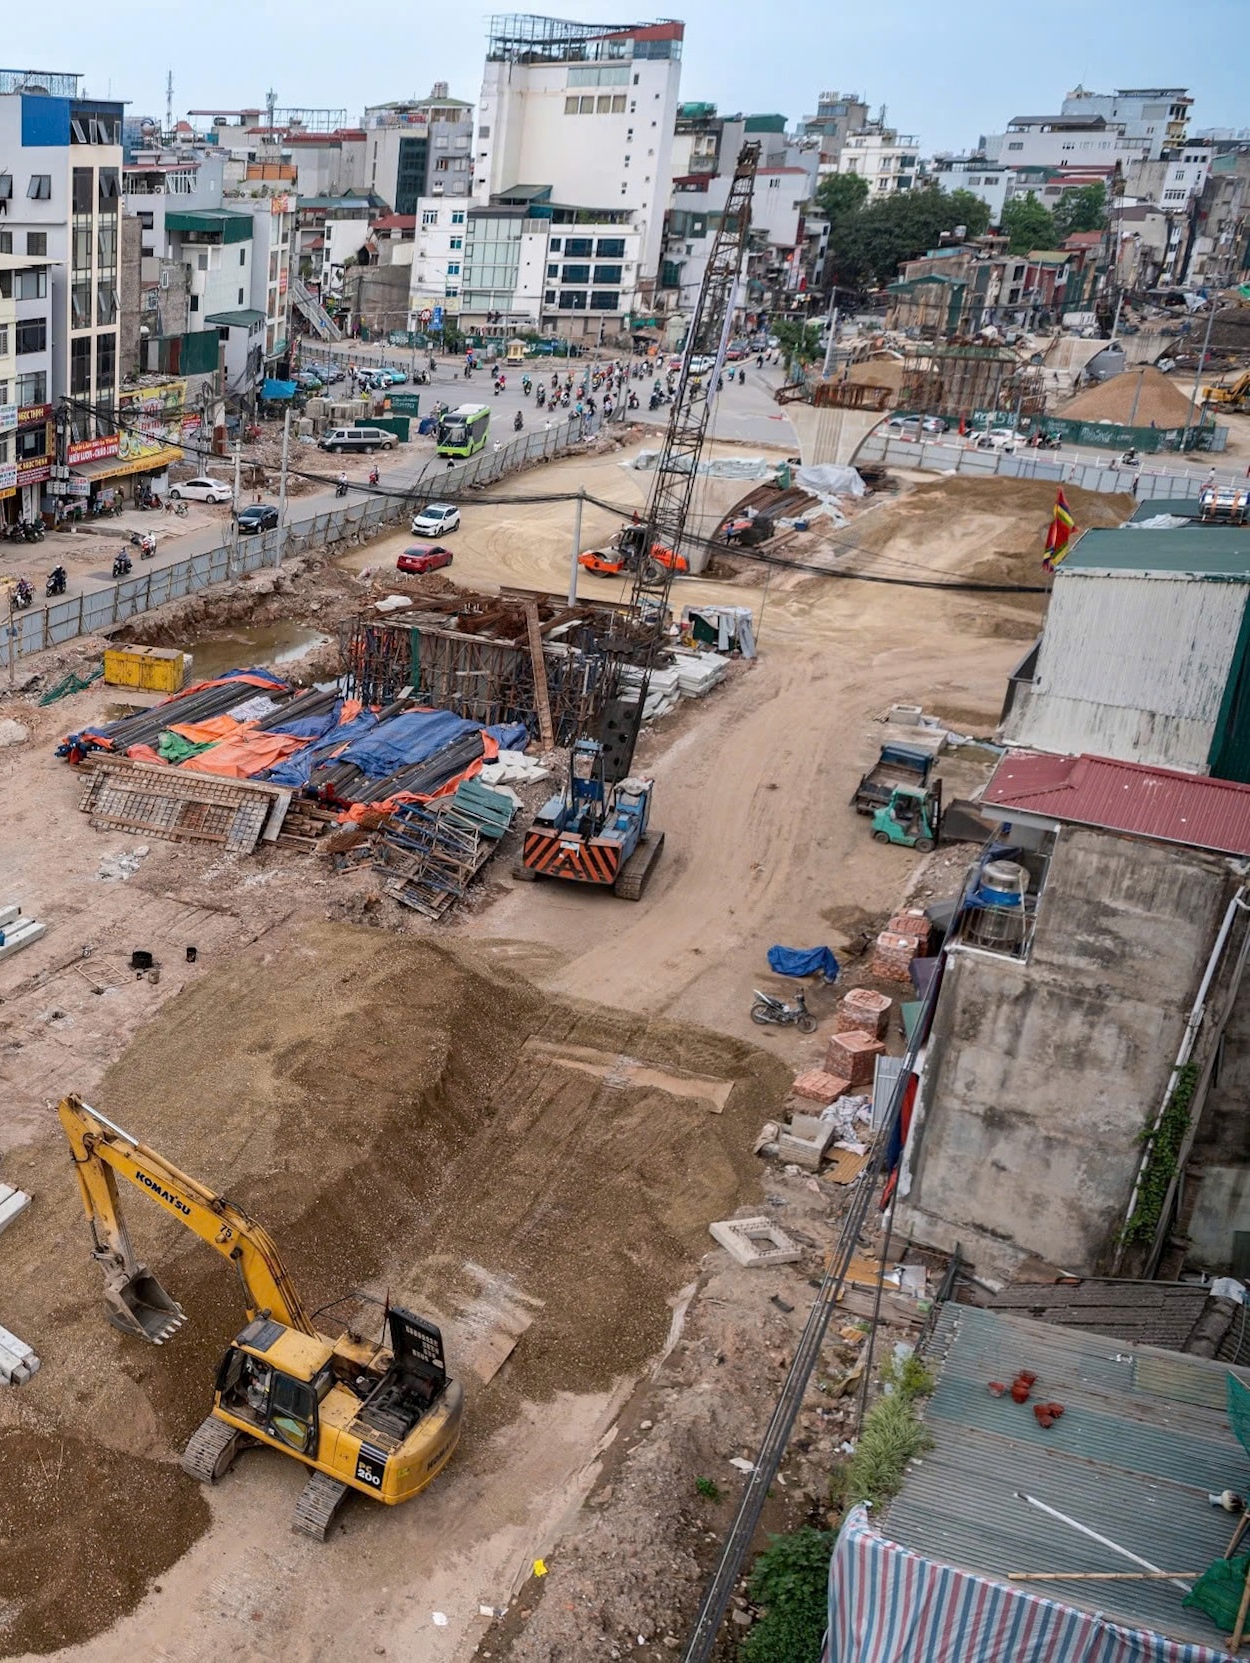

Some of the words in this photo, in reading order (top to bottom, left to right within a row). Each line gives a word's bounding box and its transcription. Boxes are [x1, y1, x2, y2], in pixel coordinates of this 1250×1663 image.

[135, 1170, 191, 1216] KOMATSU
[219, 1222, 233, 1238] 75
[358, 1461, 372, 1474] PC
[356, 1468, 381, 1486] 200
